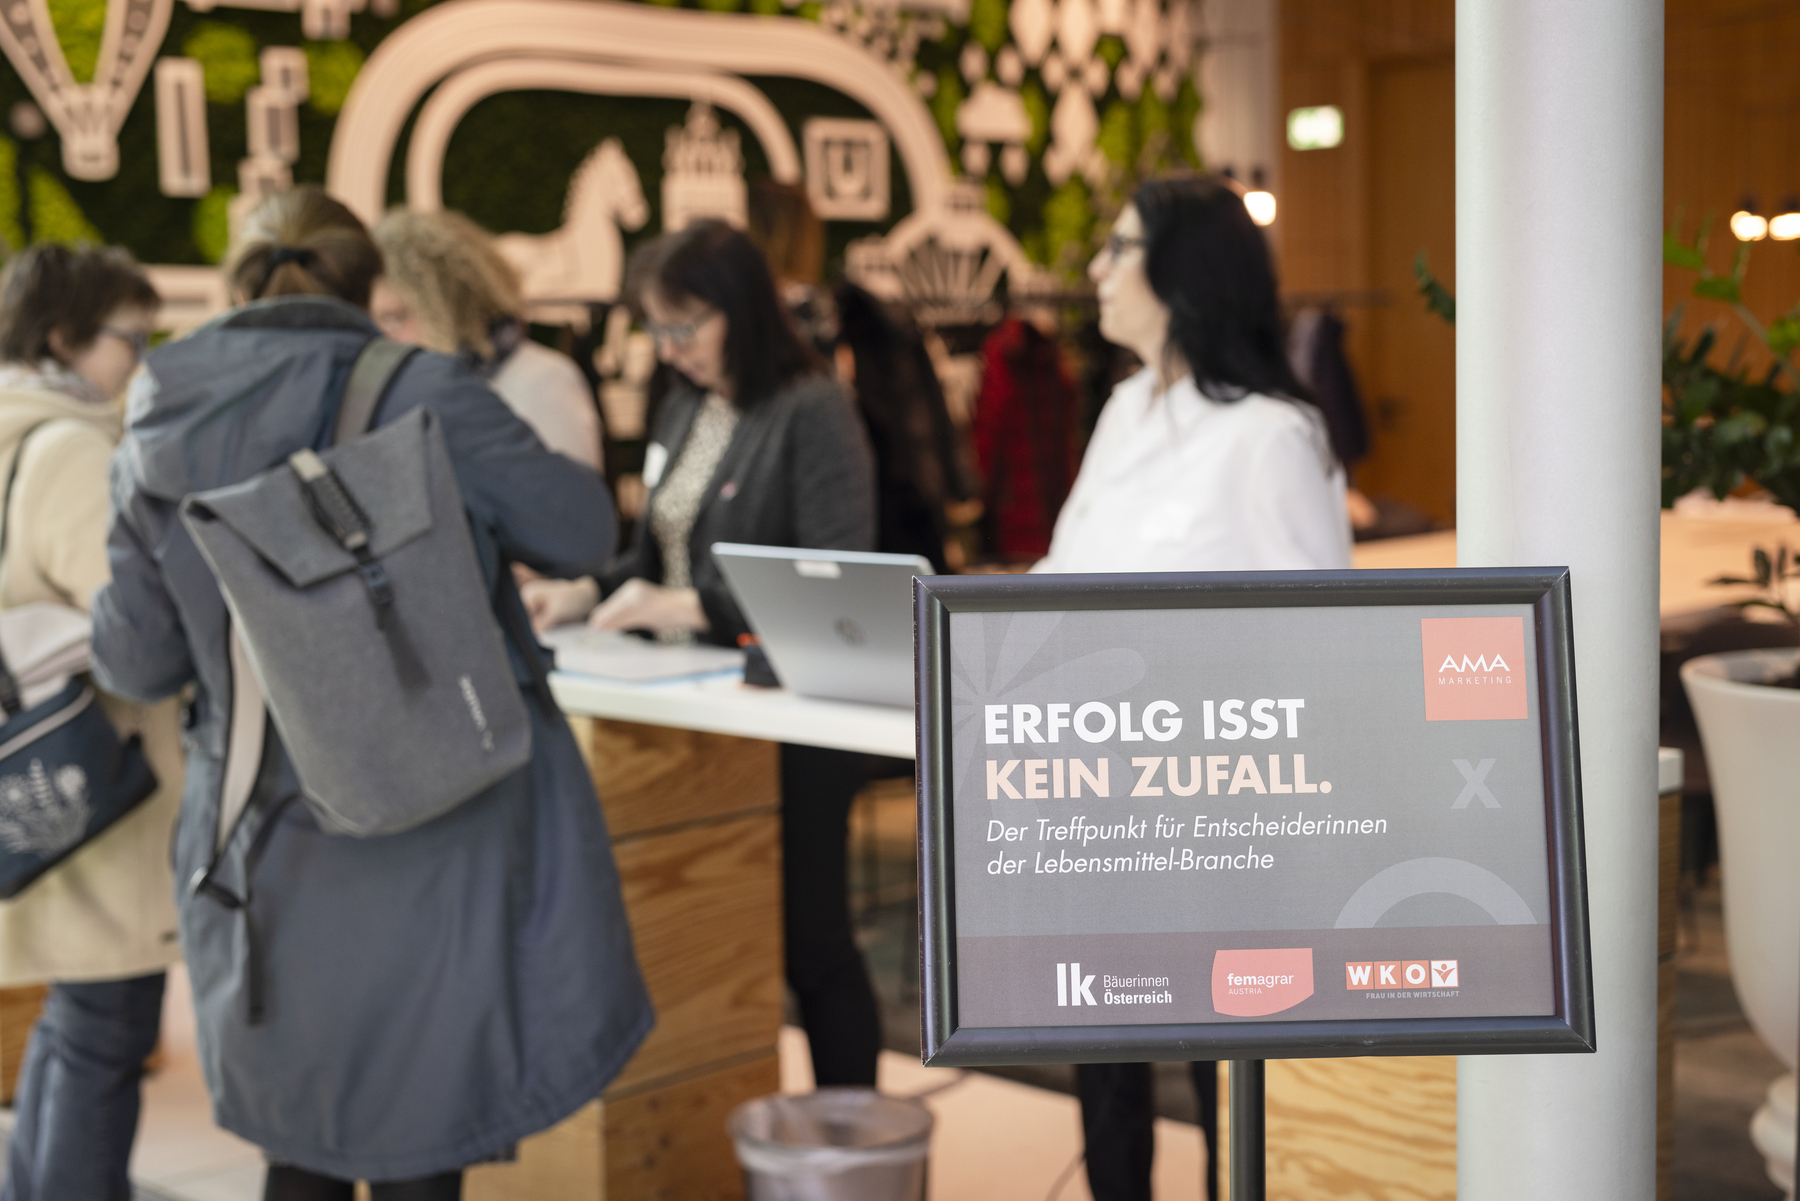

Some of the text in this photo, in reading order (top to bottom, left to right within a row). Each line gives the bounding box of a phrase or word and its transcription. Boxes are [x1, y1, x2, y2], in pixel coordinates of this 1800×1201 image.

[1438, 653, 1511, 673] AMA
[1438, 676, 1512, 685] MARKETING
[984, 698, 1305, 745] ERFOLG ISST
[985, 753, 1333, 800] KEIN ZUFALL.
[986, 811, 1388, 847] Der Treffpunkt für Entscheiderinnen
[986, 846, 1275, 875] der Lebensmittel-Branche
[1103, 973, 1169, 988] Bäuerinnen
[1226, 973, 1295, 989] femagrar
[1347, 964, 1426, 986] WKO
[1103, 989, 1173, 1005] Österreich
[1413, 990, 1460, 998] WIRTSCHAFT
